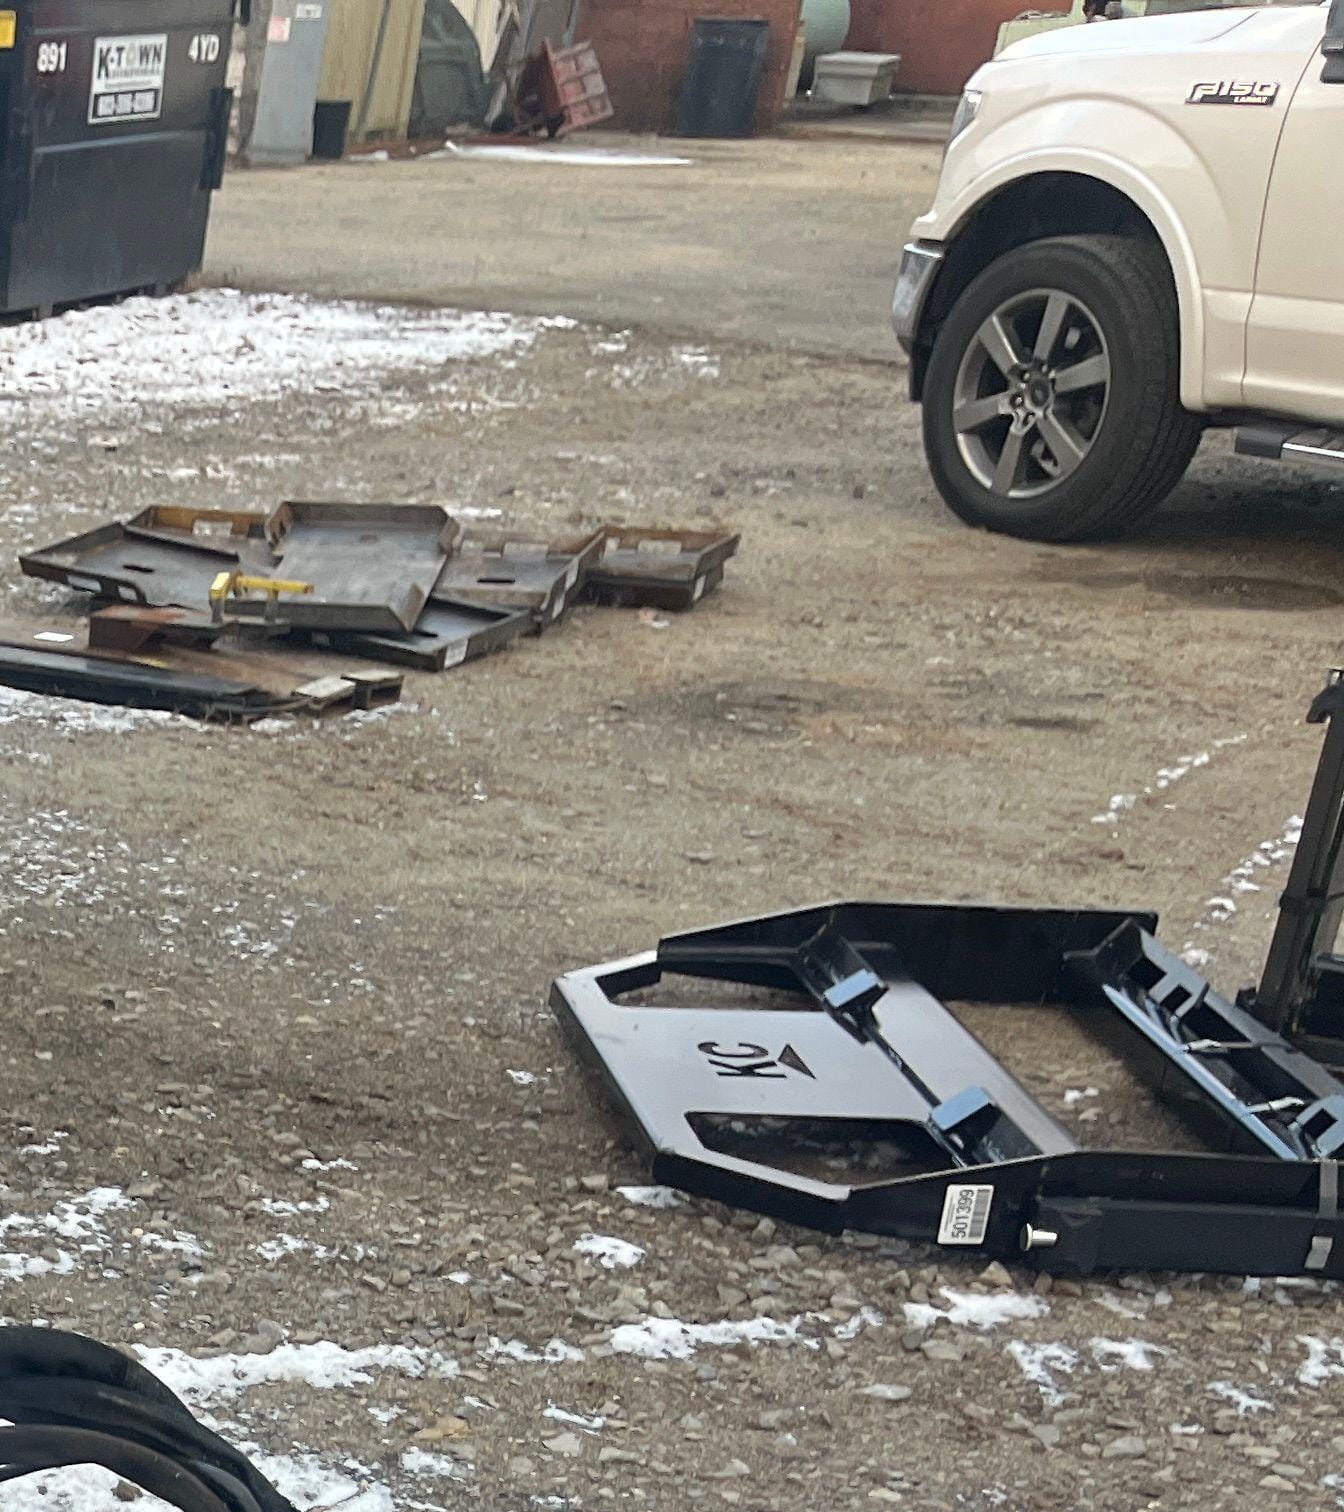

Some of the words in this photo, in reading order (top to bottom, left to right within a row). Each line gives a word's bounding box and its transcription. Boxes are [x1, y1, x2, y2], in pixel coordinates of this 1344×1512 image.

[37, 42, 68, 73] 891
[188, 34, 220, 63] 4YD
[697, 1042, 787, 1078] KC
